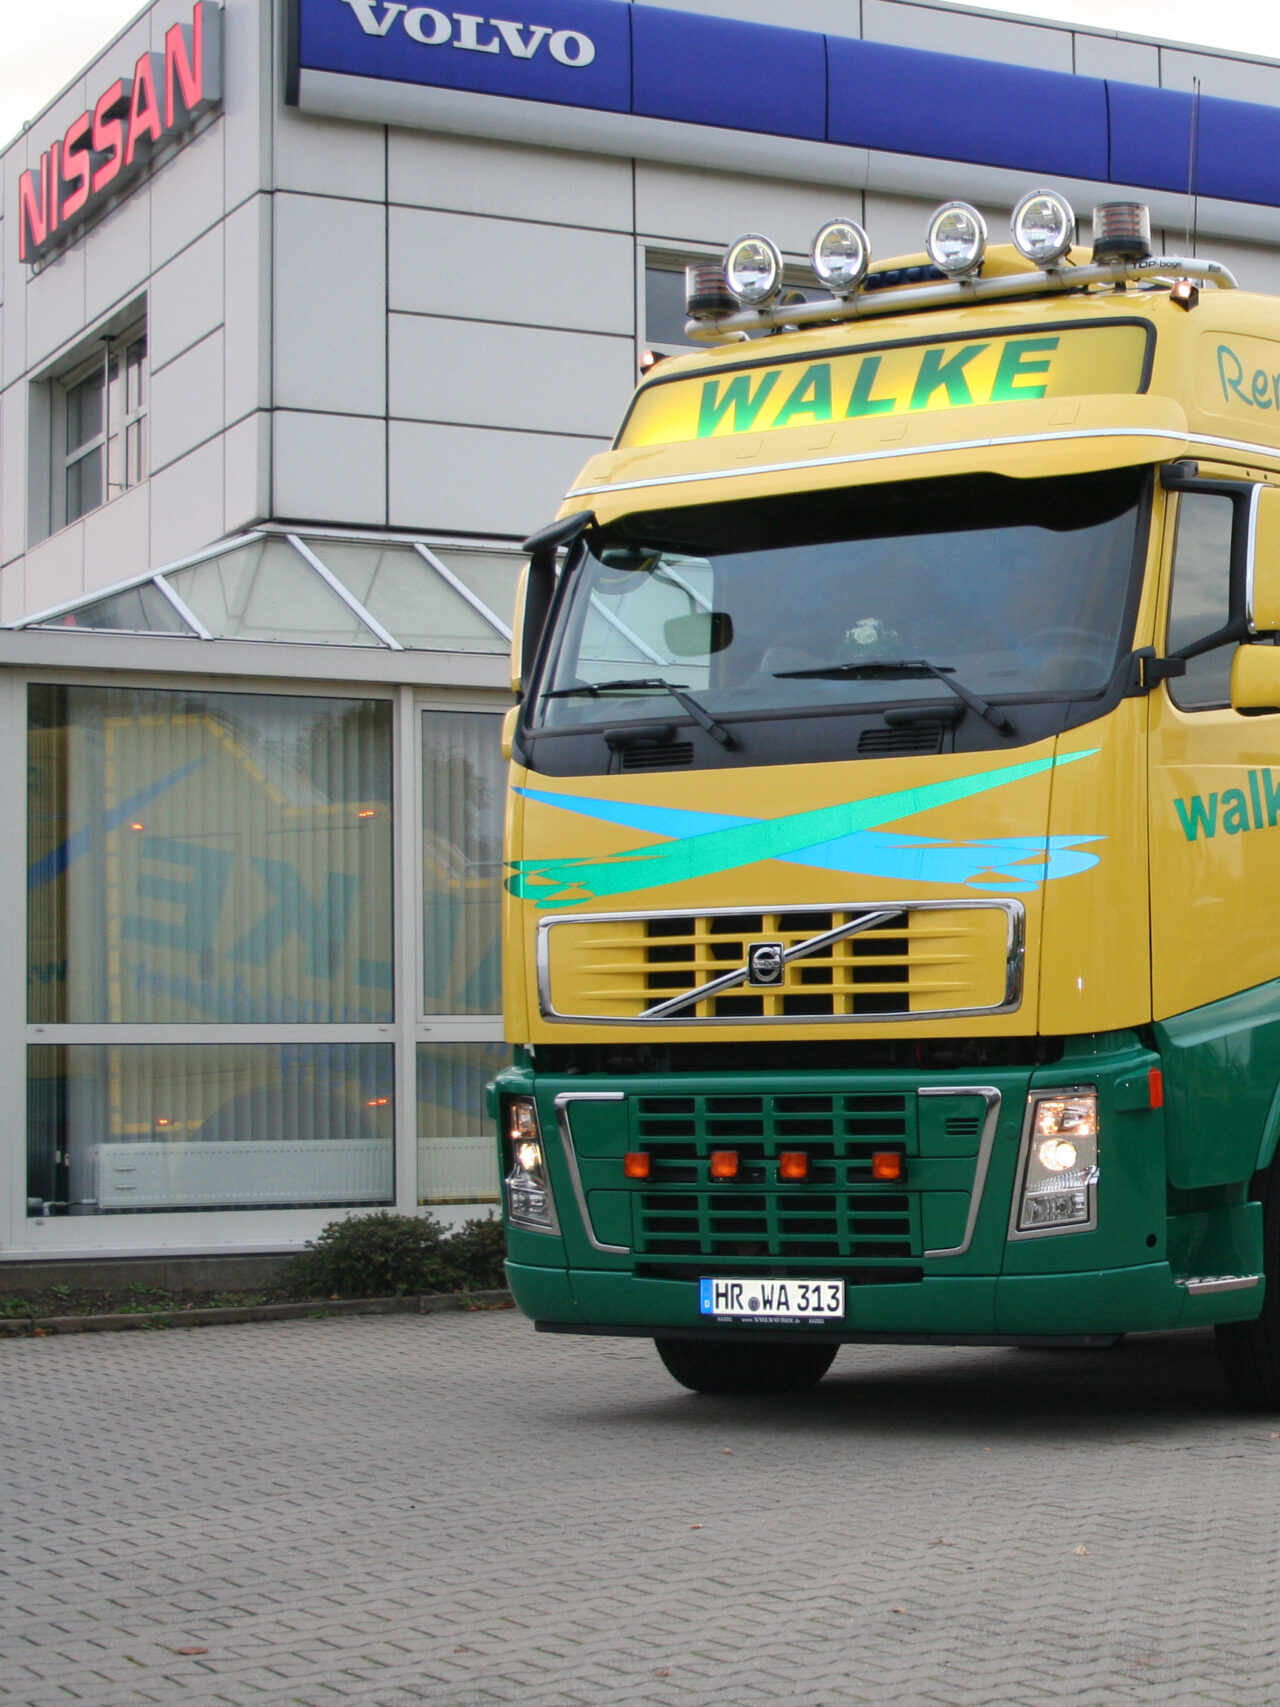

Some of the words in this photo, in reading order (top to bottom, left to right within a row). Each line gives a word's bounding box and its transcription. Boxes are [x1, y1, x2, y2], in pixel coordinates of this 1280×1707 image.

[341, 0, 596, 67] VOLVO
[18, 0, 204, 262] NISSAN
[696, 336, 1060, 439] WALKE
[715, 1283, 744, 1310] HR
[761, 1284, 790, 1311] WA
[797, 1284, 840, 1312] 313
